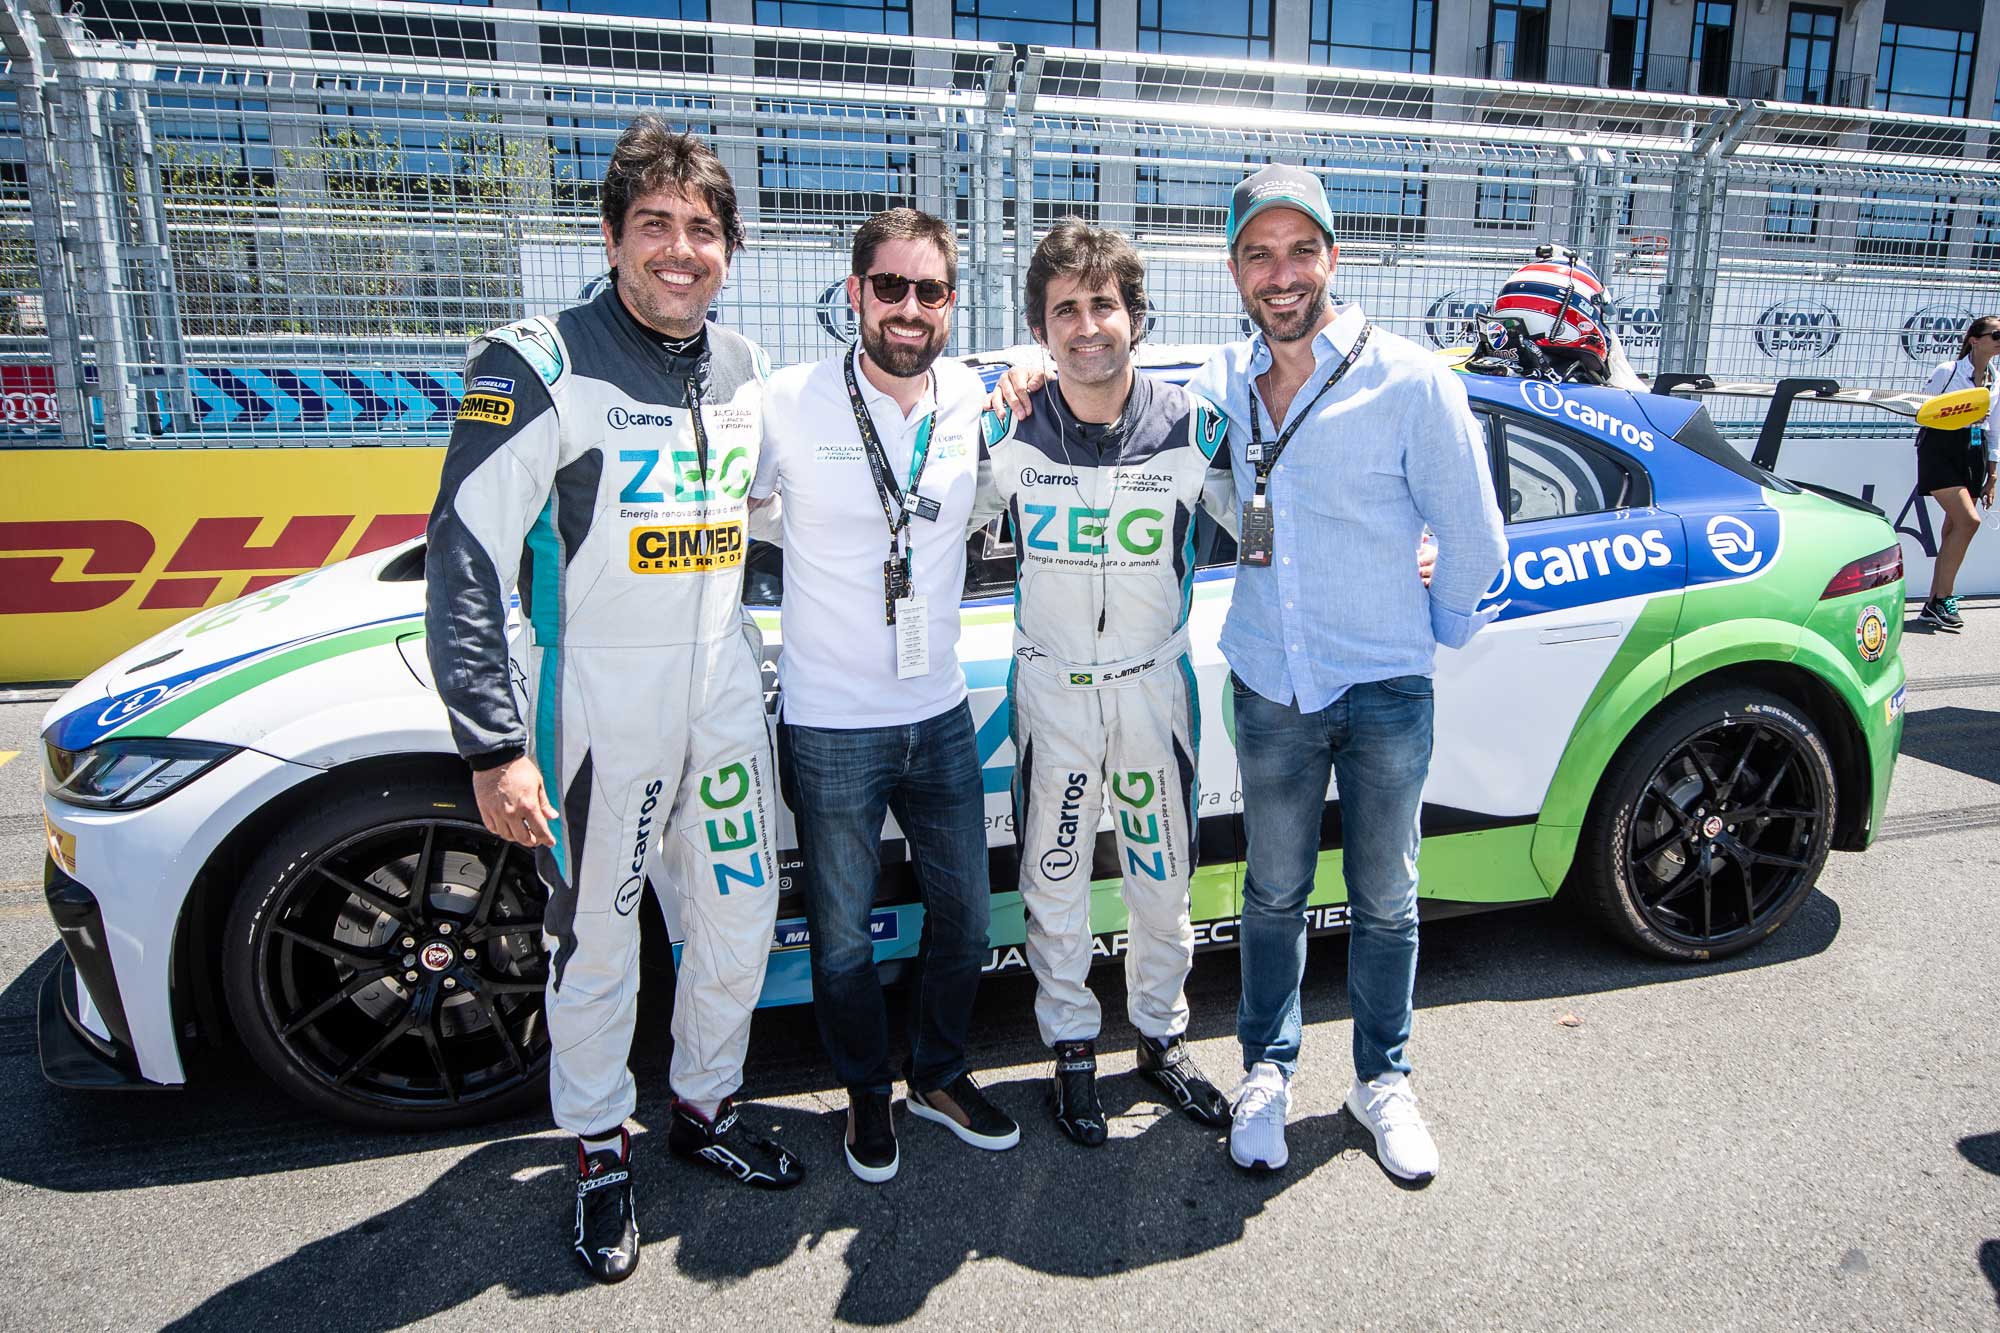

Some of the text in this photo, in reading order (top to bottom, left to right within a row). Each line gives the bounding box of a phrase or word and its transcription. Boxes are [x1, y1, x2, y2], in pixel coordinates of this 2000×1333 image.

[1248, 180, 1306, 197] JAGUAR
[1447, 301, 1488, 331] FO
[1772, 312, 1825, 339] FOX
[1918, 316, 1967, 343] FOX
[1617, 336, 1660, 347] SPORT
[1771, 340, 1822, 351] SPORTS
[461, 397, 510, 416] CIMED
[1940, 403, 1973, 418] DHL
[619, 446, 752, 503] ZEG
[1113, 473, 1173, 482] JAGUAR
[620, 509, 658, 520] Energia
[1024, 503, 1164, 556] ZEG
[1028, 552, 1053, 564] Energia
[1507, 530, 1672, 590] carros
[1102, 658, 1156, 681] S. JIMENEZ
[700, 761, 765, 895] ZEG
[1112, 771, 1166, 881] ZEG
